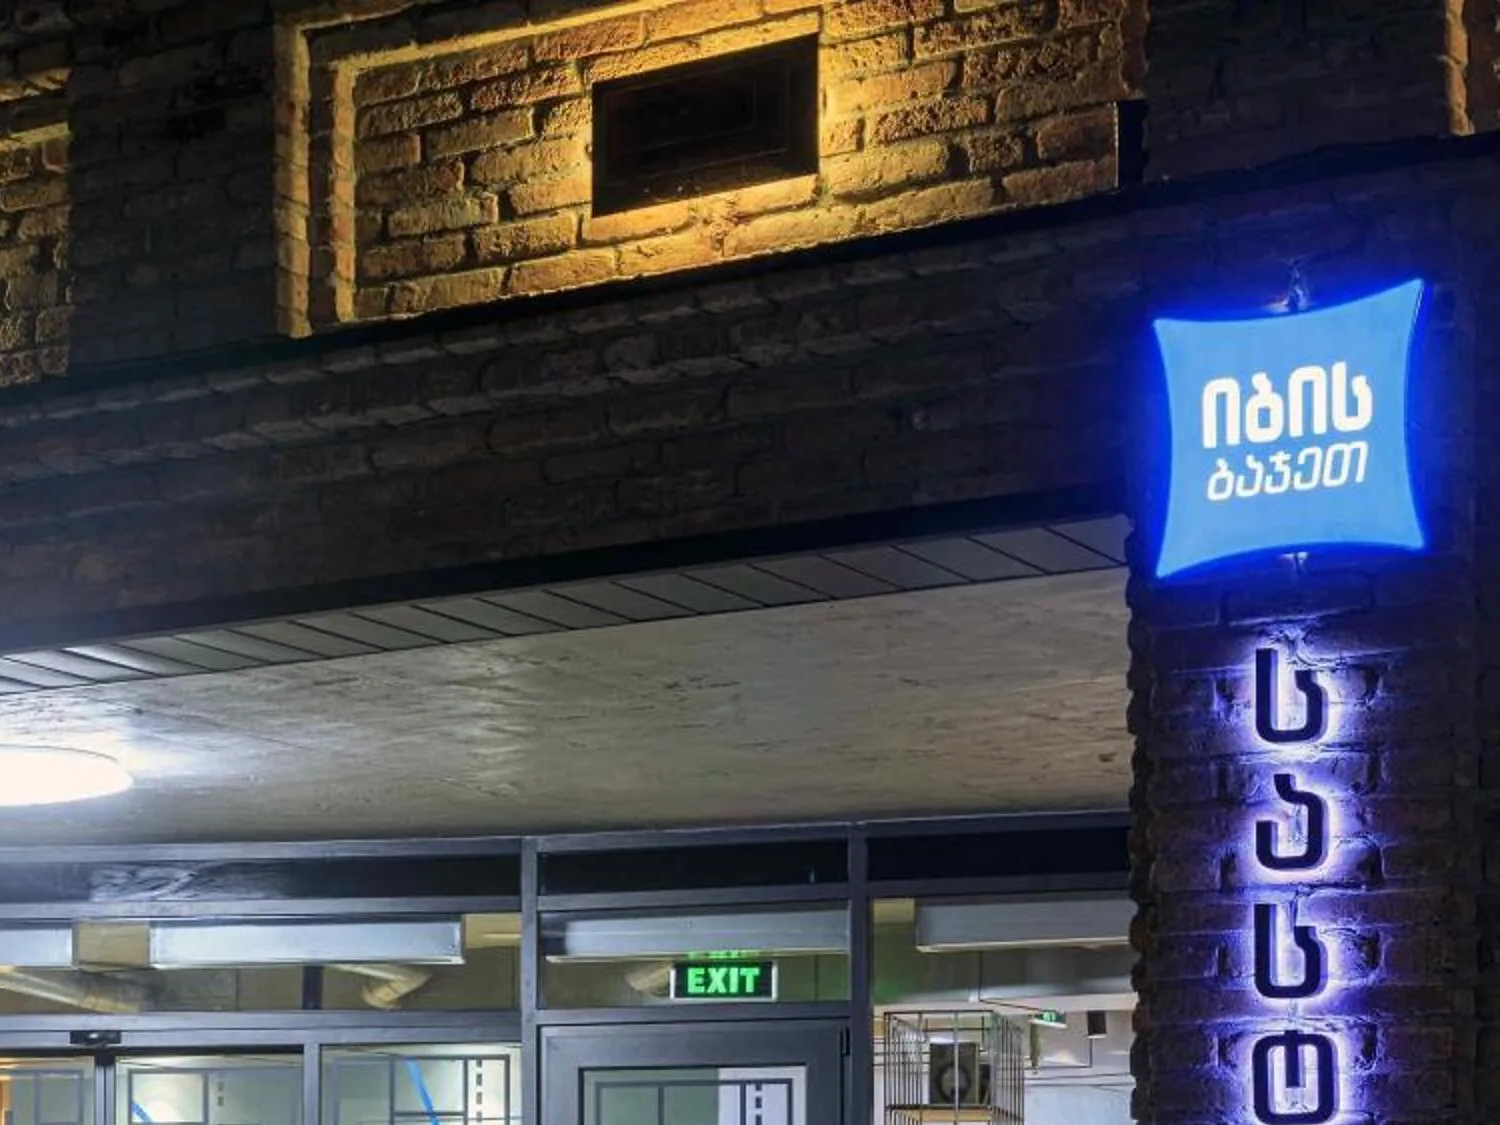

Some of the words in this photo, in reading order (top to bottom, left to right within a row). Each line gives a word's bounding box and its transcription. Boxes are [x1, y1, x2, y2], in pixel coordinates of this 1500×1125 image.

[1202, 361, 1373, 449] იბის
[1206, 441, 1369, 501] ბაჯეთ
[686, 966, 760, 993] EXIT
